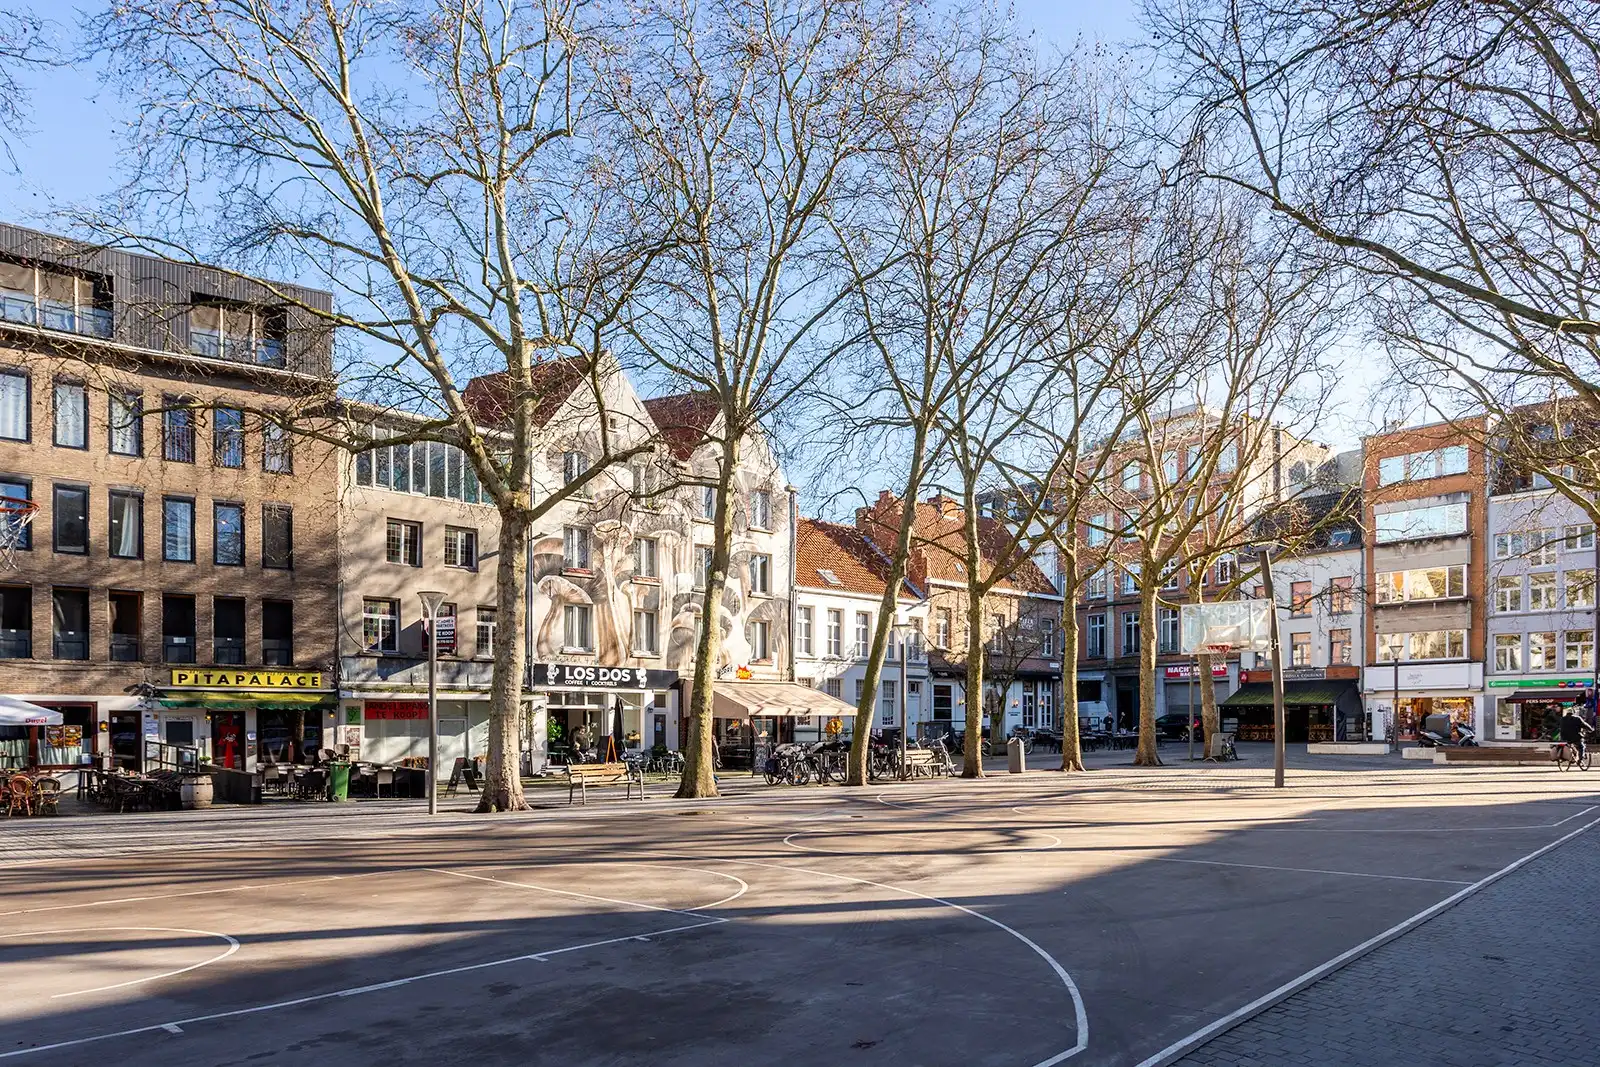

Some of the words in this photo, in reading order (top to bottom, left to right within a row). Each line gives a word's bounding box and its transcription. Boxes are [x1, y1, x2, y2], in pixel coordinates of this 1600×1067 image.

[178, 674, 319, 686] PITAPALACE
[565, 666, 596, 680] LOS
[599, 668, 631, 682] DOS
